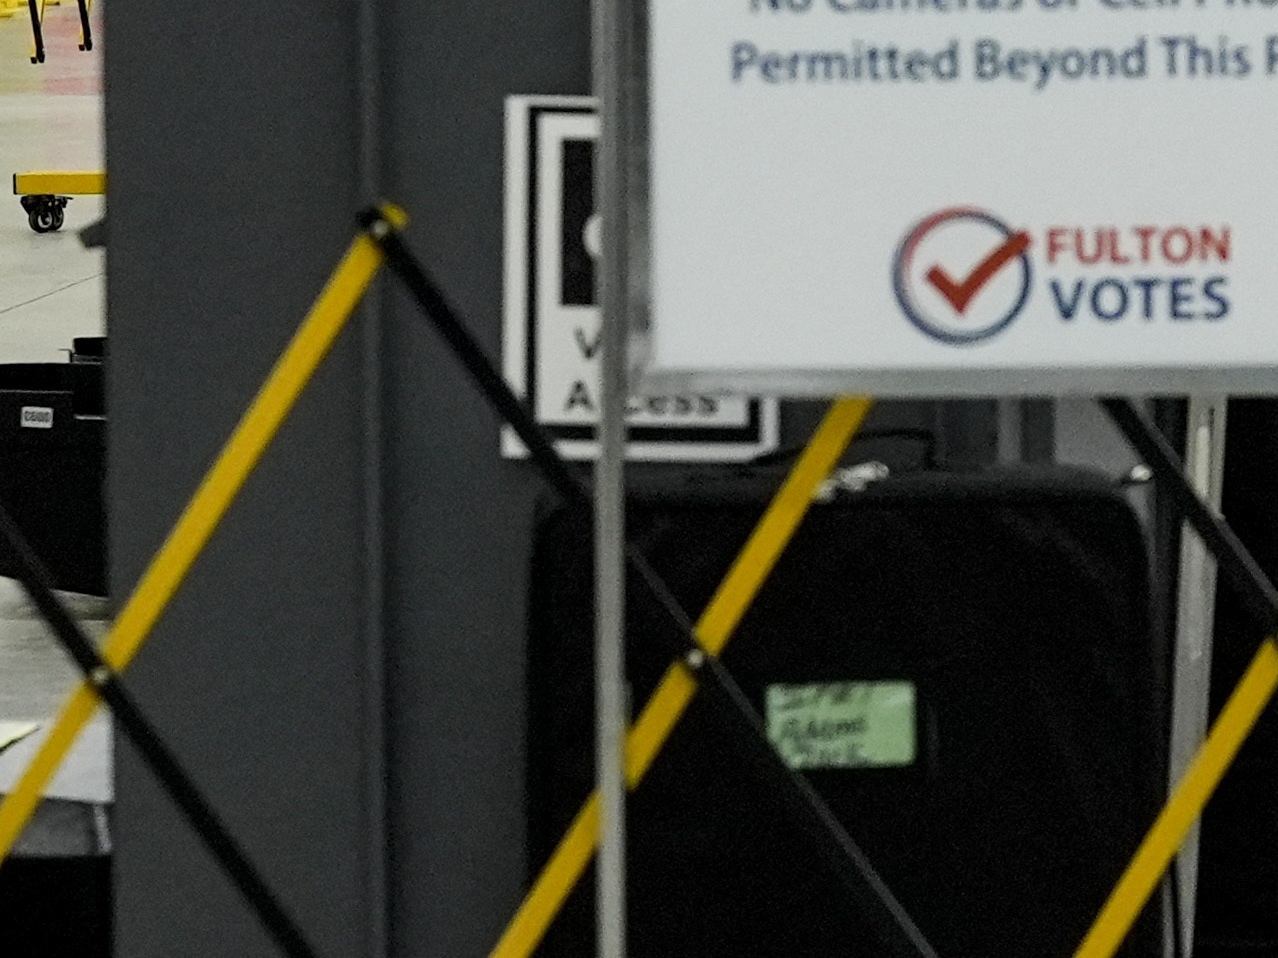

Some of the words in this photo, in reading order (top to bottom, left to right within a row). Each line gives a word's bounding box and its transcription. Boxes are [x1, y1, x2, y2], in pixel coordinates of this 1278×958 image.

[731, 40, 960, 84] Permitted
[974, 37, 1147, 90] Beyond
[1160, 36, 1252, 78] This
[1046, 227, 1230, 265] FULTON
[1049, 276, 1230, 322] VOTES
